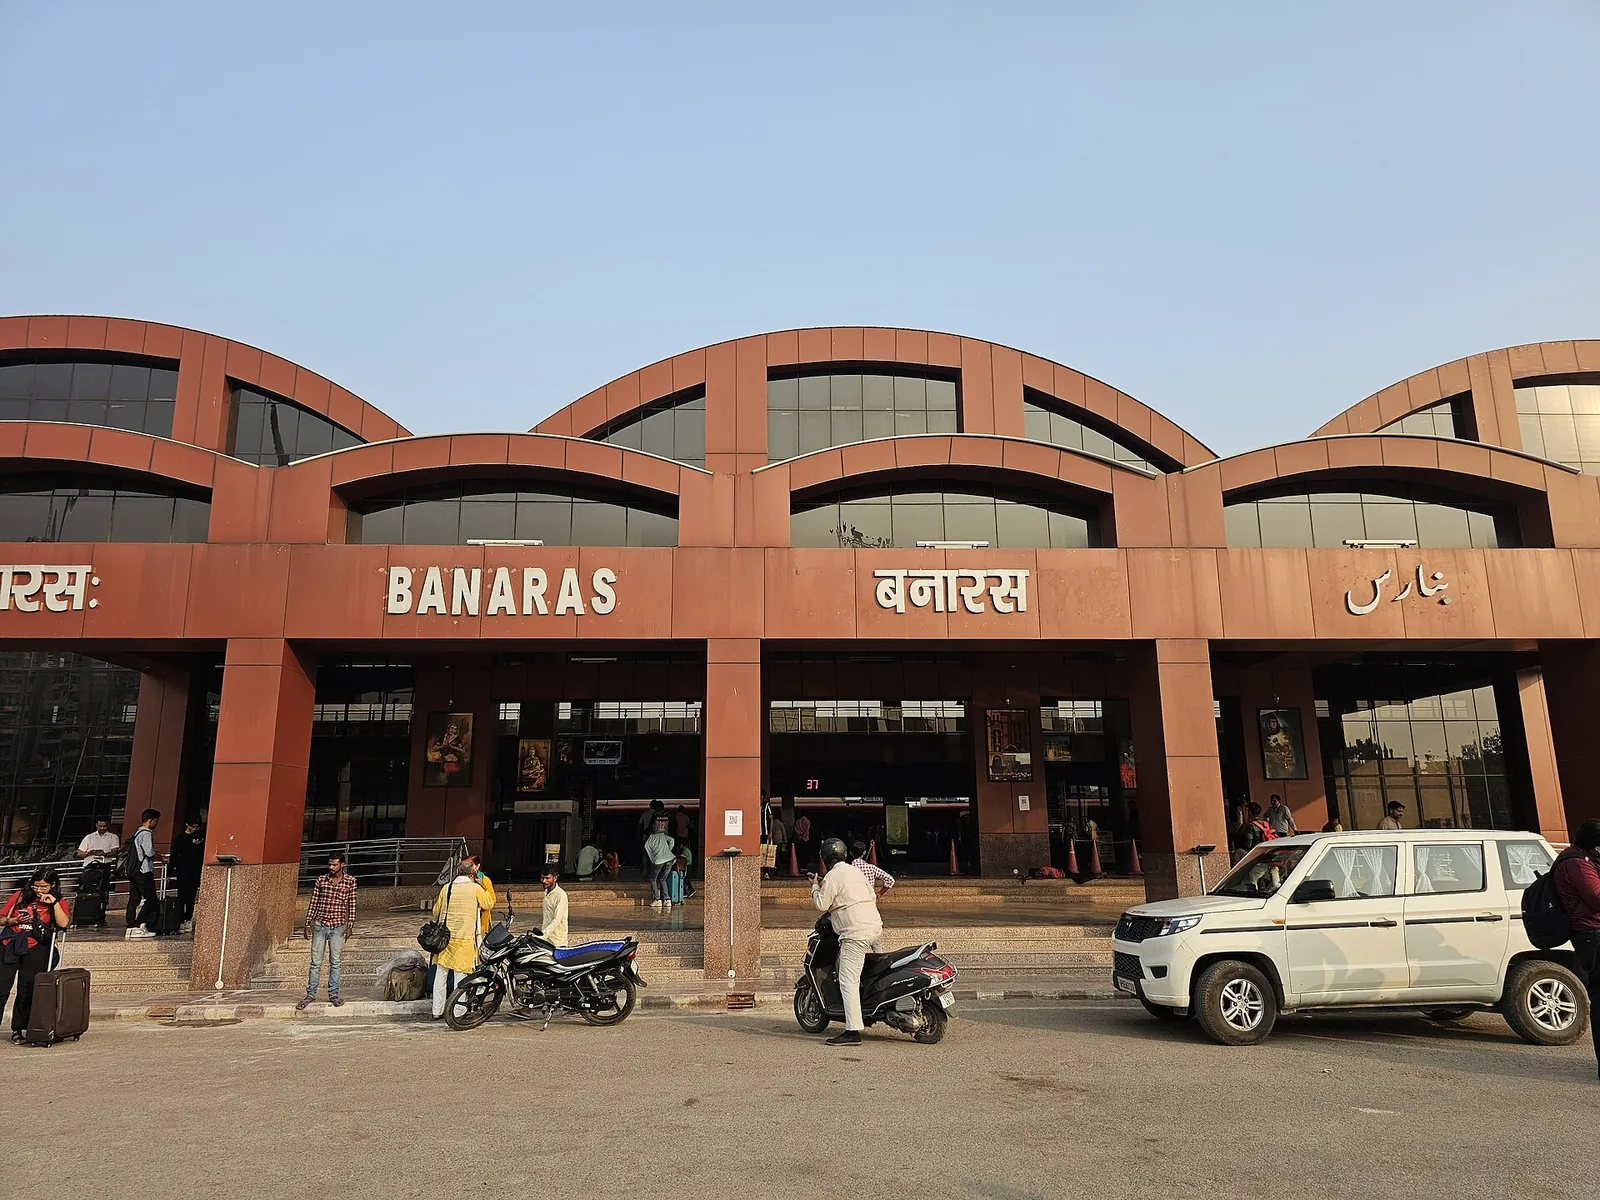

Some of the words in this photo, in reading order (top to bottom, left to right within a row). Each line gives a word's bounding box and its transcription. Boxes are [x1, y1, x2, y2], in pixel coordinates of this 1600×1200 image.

[387, 566, 617, 615] BANARAS
[873, 569, 1030, 614] बनारस
[1345, 564, 1452, 616] بنارس
[806, 779, 819, 790] 37
